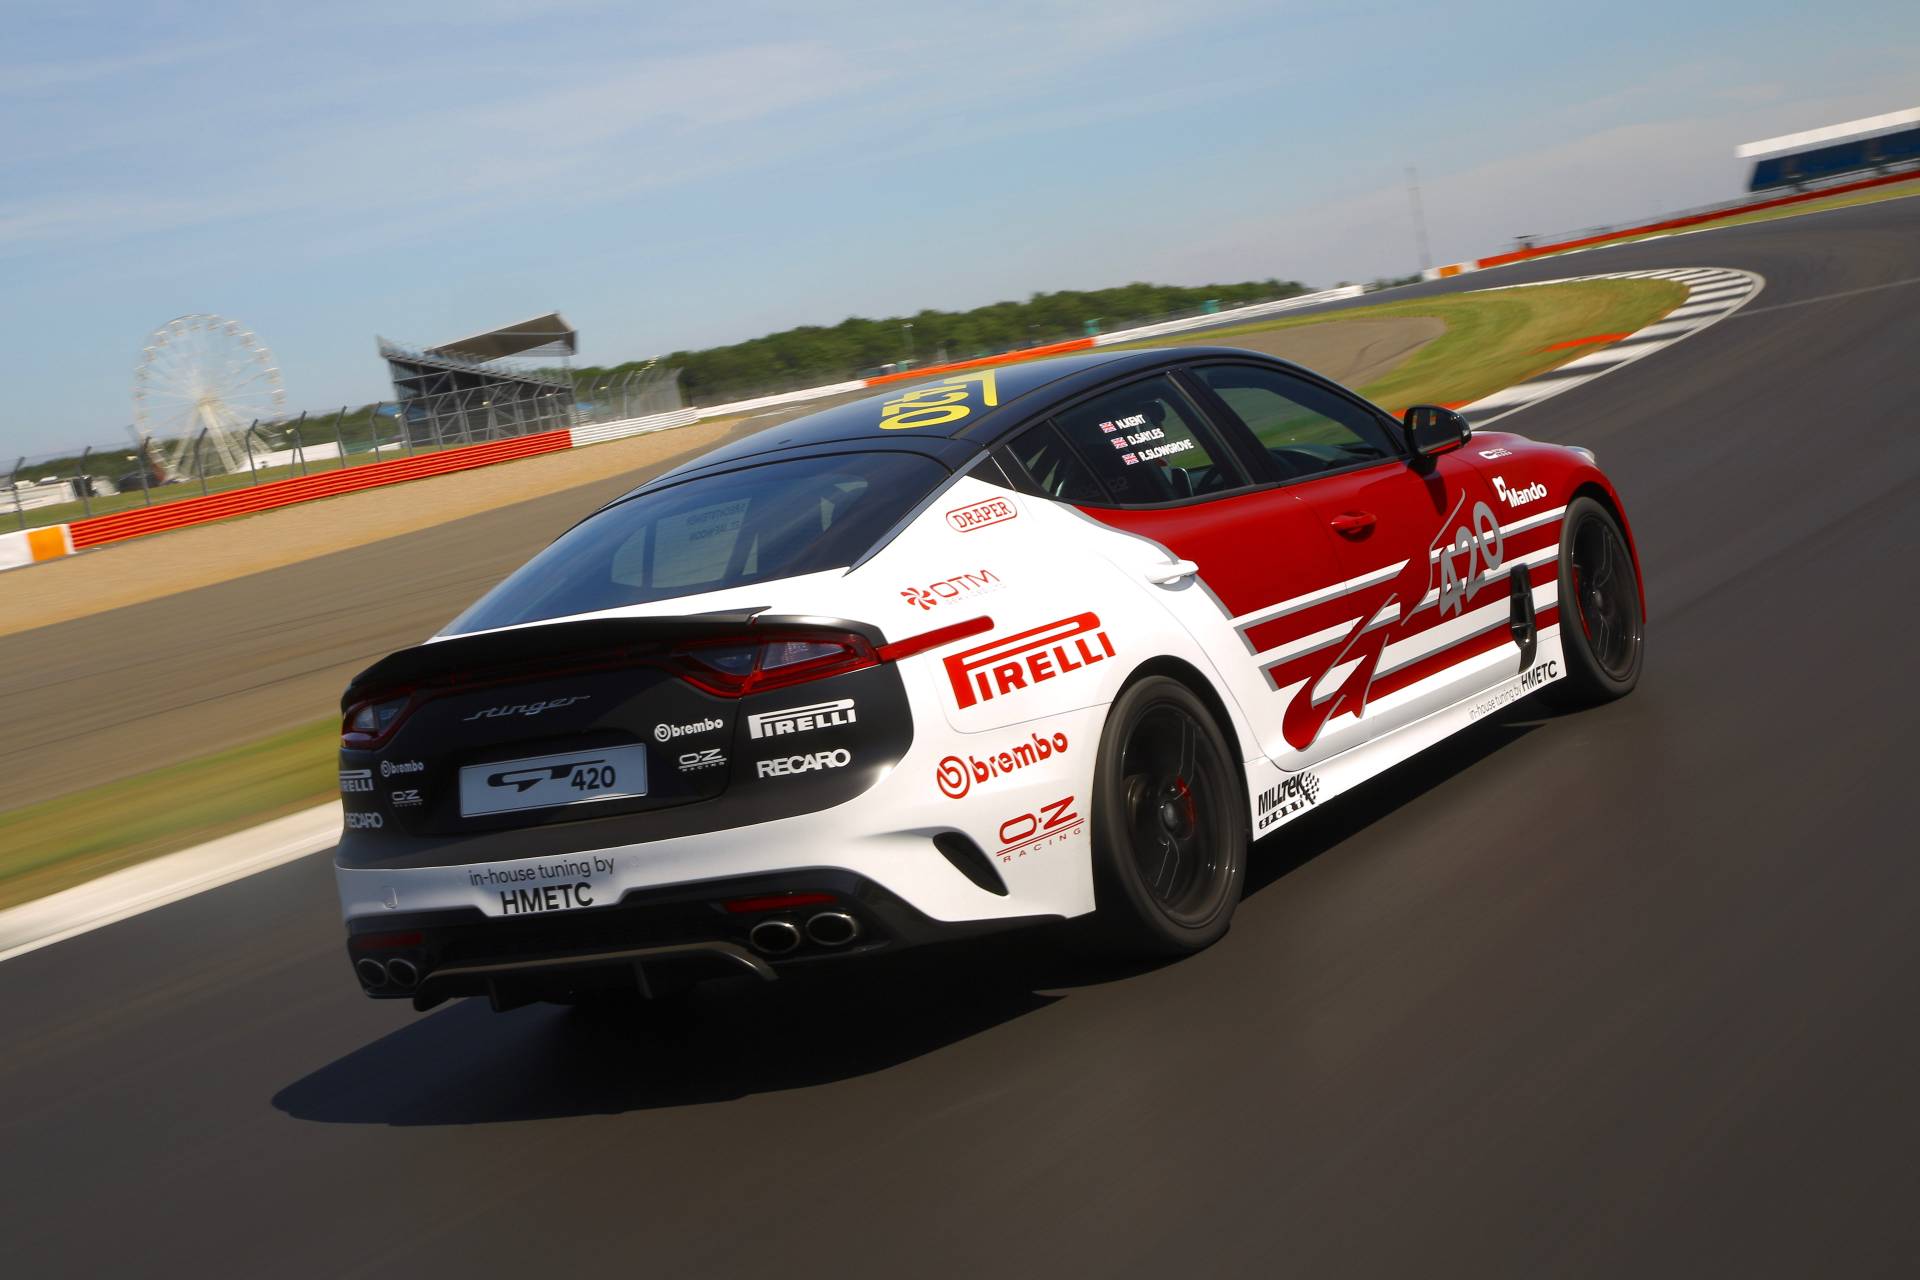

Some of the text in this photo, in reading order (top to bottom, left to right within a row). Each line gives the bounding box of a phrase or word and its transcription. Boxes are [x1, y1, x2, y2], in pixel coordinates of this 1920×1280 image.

[1115, 414, 1146, 429] N.KENT
[1127, 428, 1165, 445] D.SAYLES
[1138, 439, 1194, 461] R.SLOWGROVE
[1506, 481, 1547, 508] Mando
[953, 501, 1012, 528] DRAPER
[1439, 501, 1504, 617] 420
[929, 569, 1001, 598] OTM
[942, 611, 1117, 710] PIRELLI
[1521, 661, 1558, 692] HMETC
[671, 718, 724, 737] brembo
[748, 698, 857, 740] PIRELLI
[391, 760, 424, 774] brembo
[756, 748, 851, 779] RECARO
[969, 732, 1068, 784] brembo
[571, 765, 616, 791] 420
[1258, 799, 1304, 830] SPORT
[1003, 827, 1082, 863] RACING
[469, 855, 615, 887] in-house tuning by
[500, 881, 594, 914] HMETC
